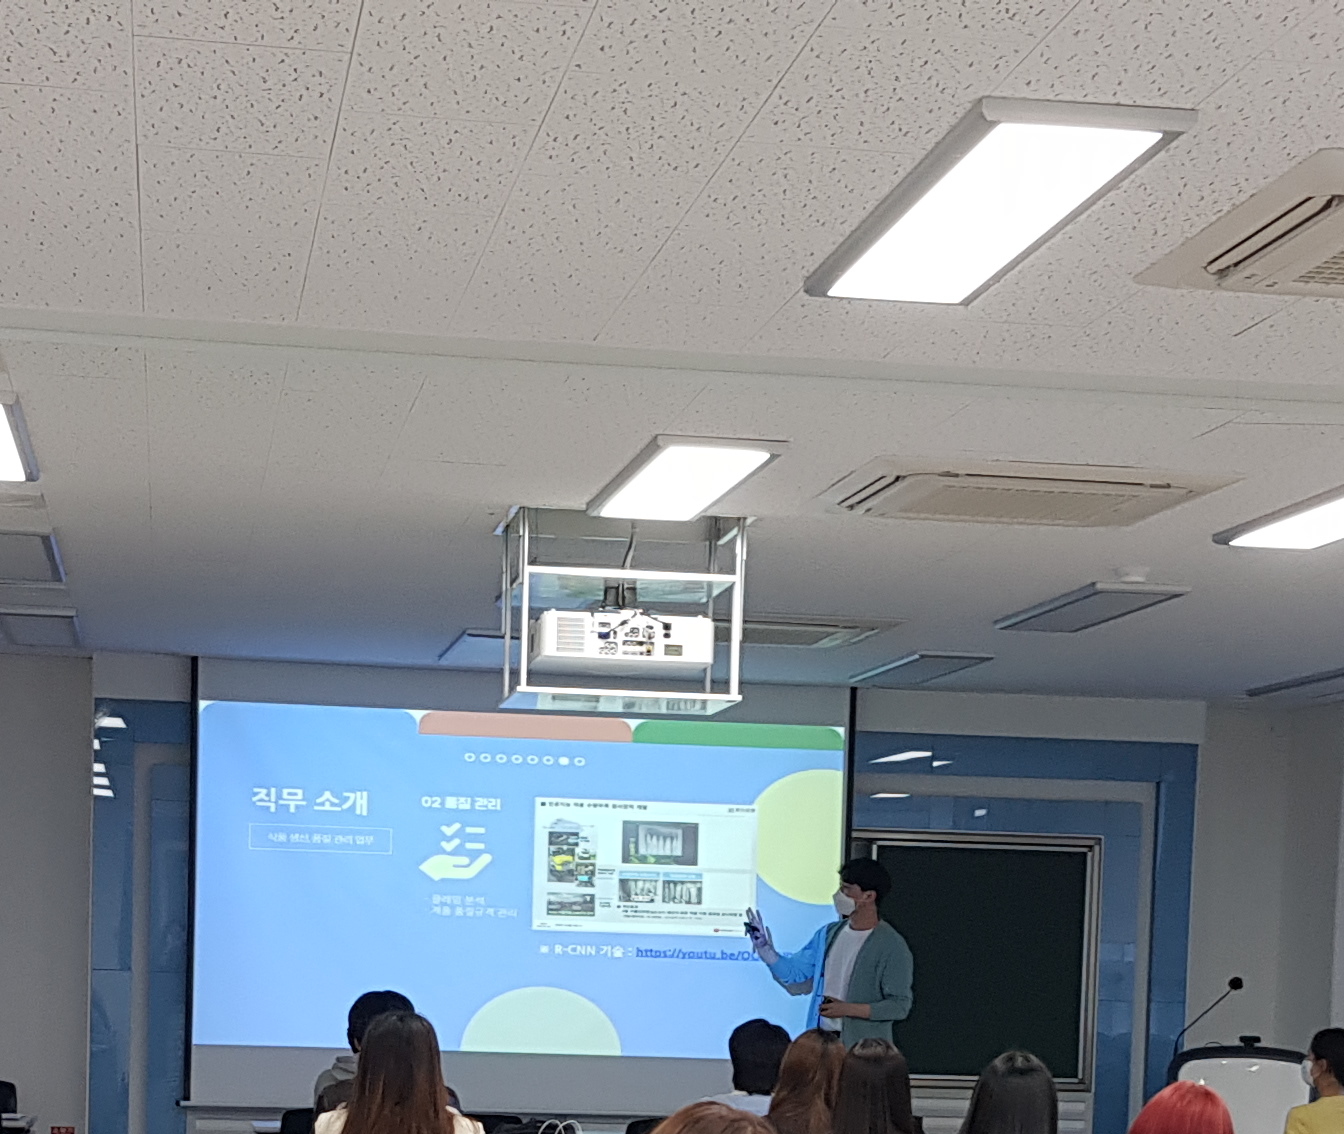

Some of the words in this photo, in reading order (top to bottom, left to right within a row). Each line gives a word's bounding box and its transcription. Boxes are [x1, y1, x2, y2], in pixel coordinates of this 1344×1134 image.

[251, 787, 307, 813] 직무
[313, 790, 369, 816] 소개
[421, 796, 441, 808] 02
[474, 797, 501, 811] 관리
[553, 944, 596, 956] R-CNN
[599, 945, 625, 958] 기술
